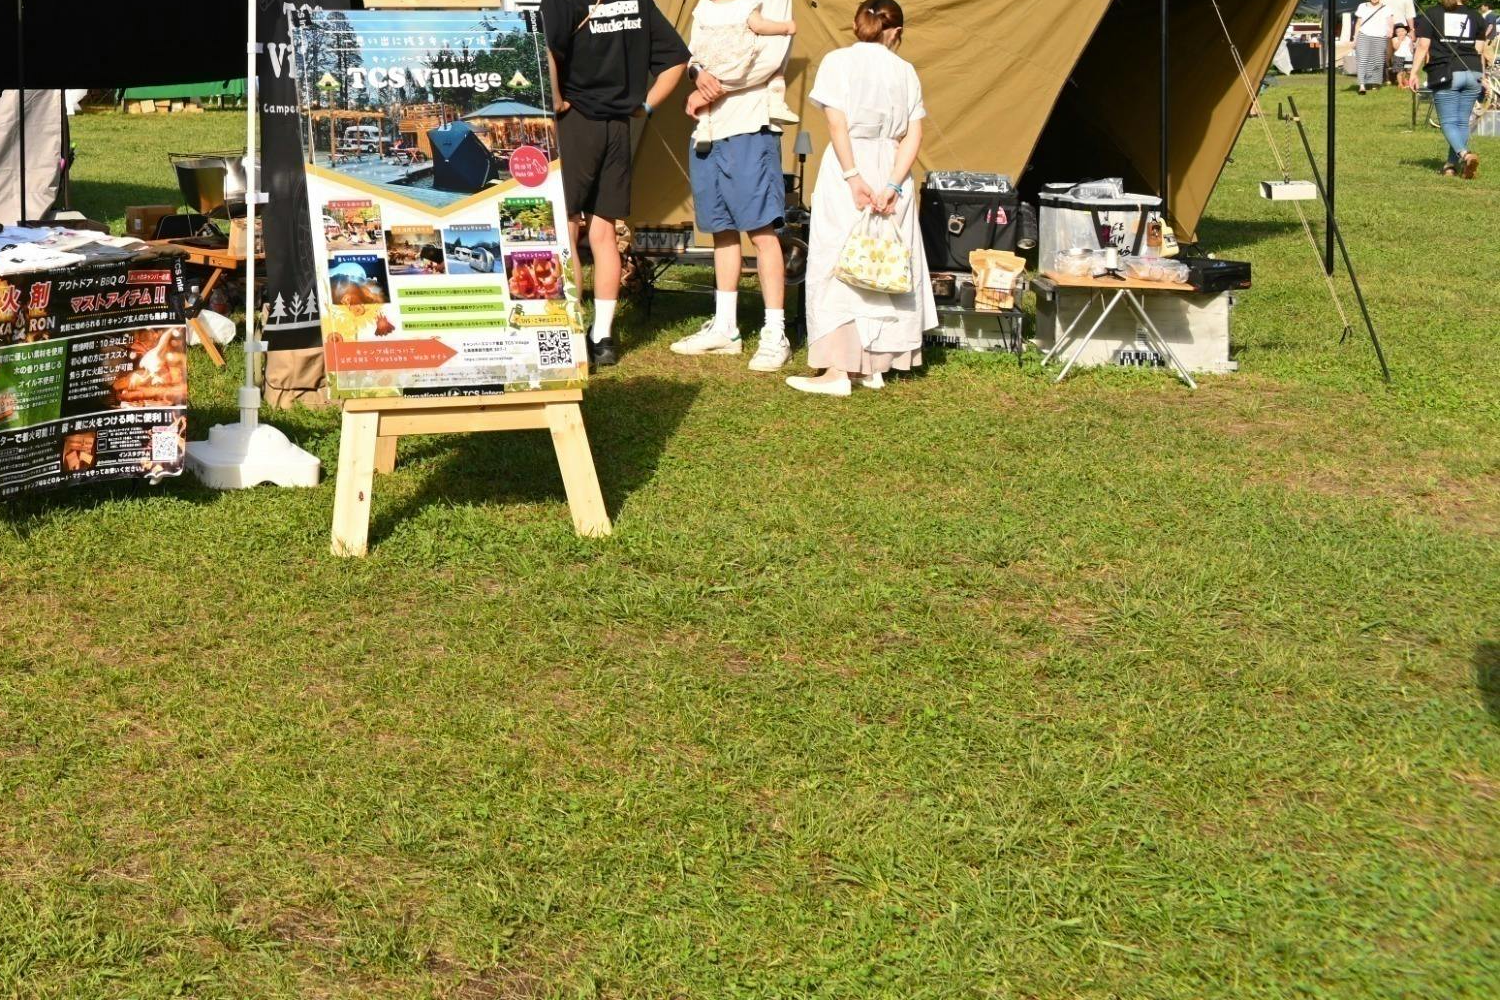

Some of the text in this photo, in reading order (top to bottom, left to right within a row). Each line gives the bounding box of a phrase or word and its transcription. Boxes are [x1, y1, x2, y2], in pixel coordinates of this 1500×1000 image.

[347, 66, 502, 92] TCS Village
[263, 103, 300, 116] Campe
[29, 317, 55, 332] RON
